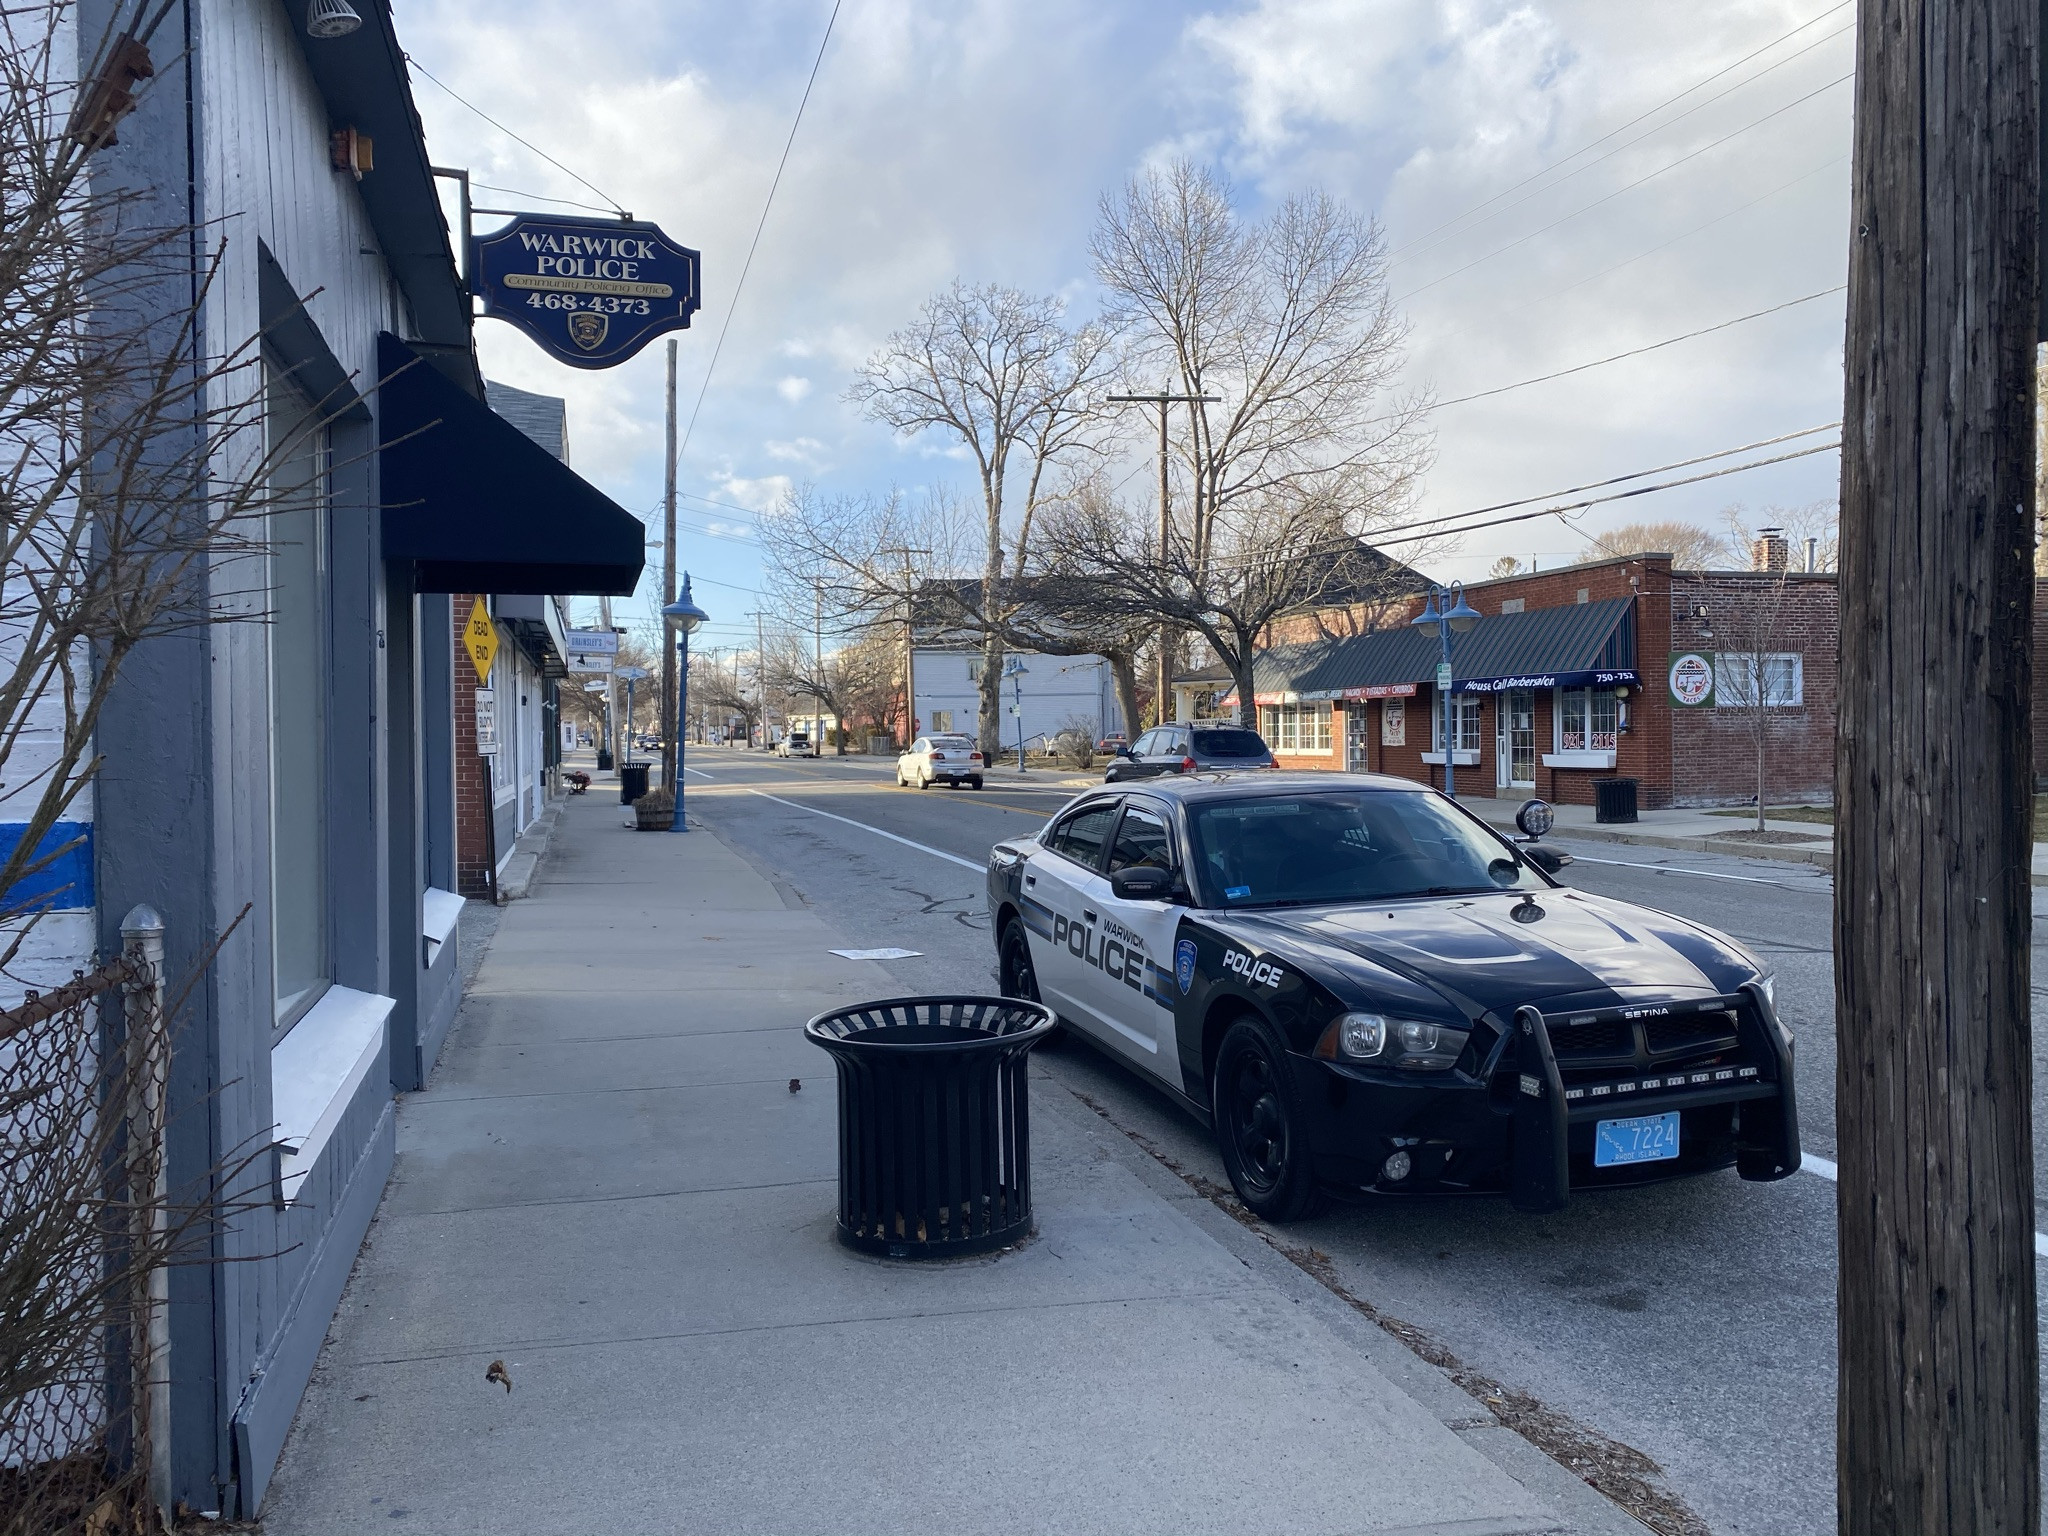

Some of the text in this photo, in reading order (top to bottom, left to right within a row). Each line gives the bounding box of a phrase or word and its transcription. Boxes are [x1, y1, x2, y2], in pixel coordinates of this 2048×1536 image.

[519, 232, 656, 259] WARWICK
[537, 255, 640, 281] POLICE
[508, 275, 671, 296] Community Policing Office
[473, 620, 488, 636] DEAD
[476, 645, 488, 660] END
[1465, 675, 1555, 691] House Call Barbersalon
[477, 701, 493, 712] DO NOT
[1591, 733, 1616, 750] 2115
[1103, 918, 1145, 950] WARWICK
[1053, 912, 1145, 993] POLICE
[1222, 948, 1284, 989] POLICE
[1624, 1007, 1669, 1019] SETINA
[1616, 1118, 1662, 1129] OCEAN STATE
[1601, 1131, 1624, 1153] POLICE
[1631, 1122, 1674, 1150] 7224
[1615, 1149, 1661, 1160] RHODE ISLAND
